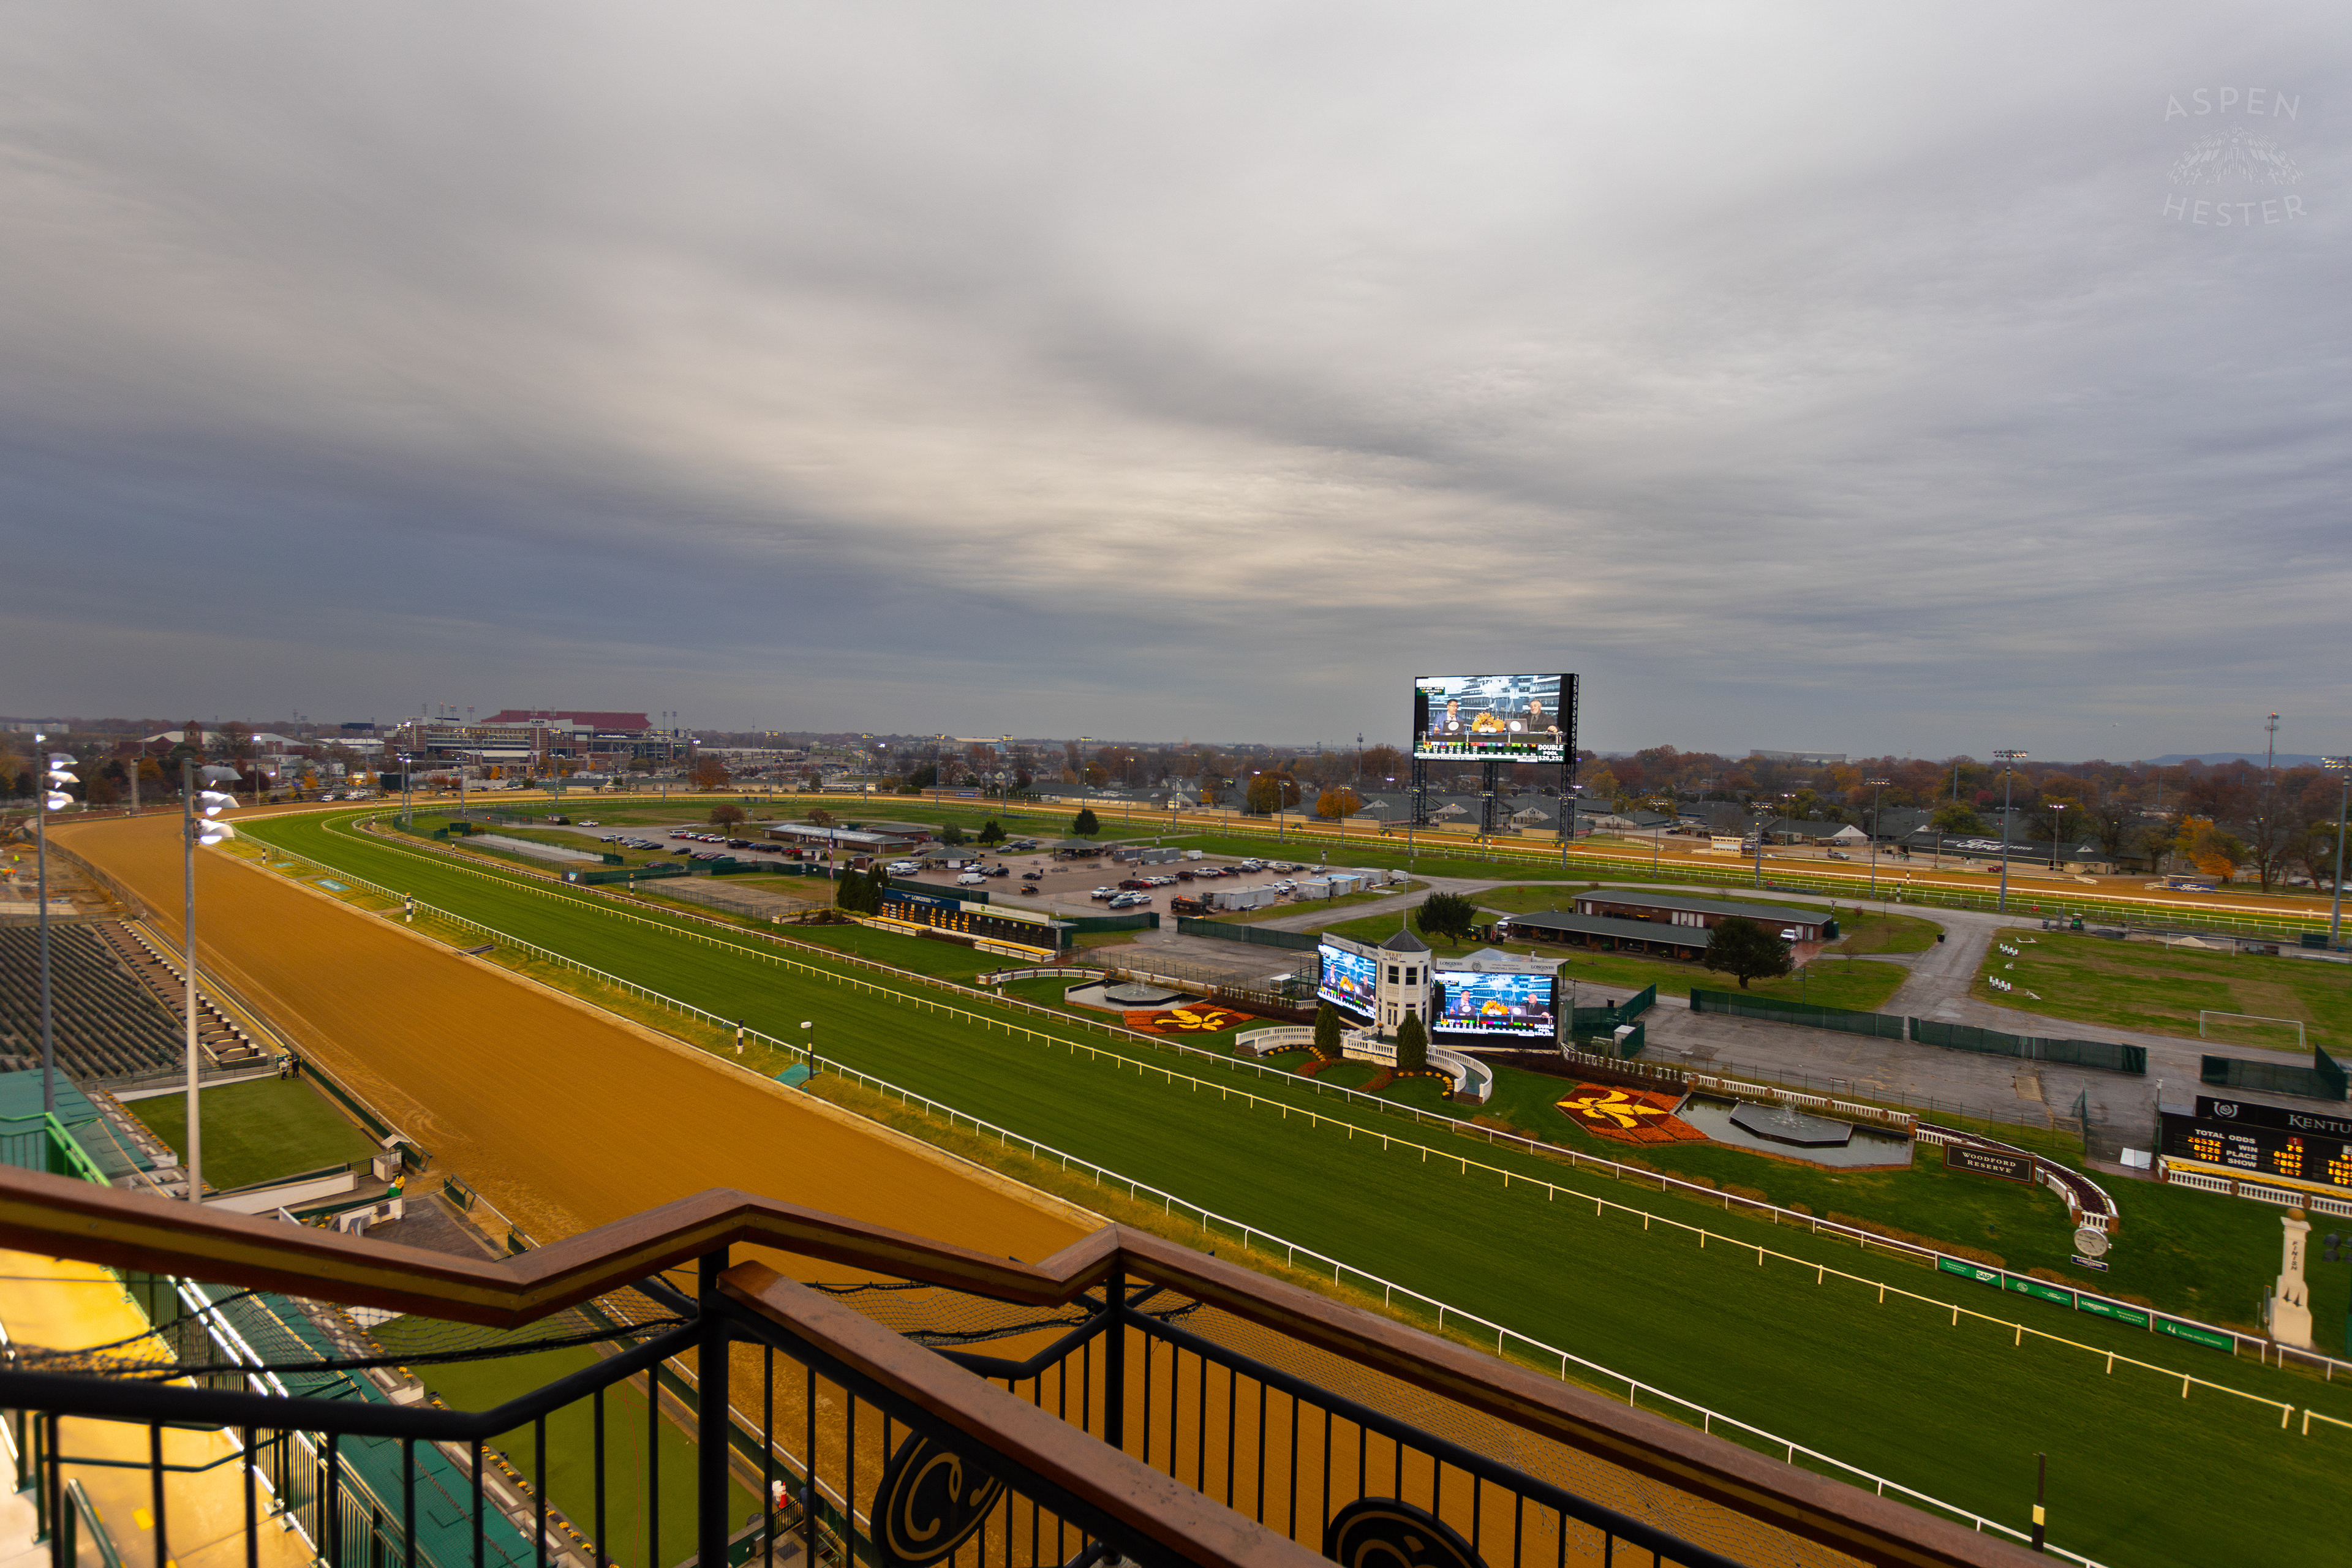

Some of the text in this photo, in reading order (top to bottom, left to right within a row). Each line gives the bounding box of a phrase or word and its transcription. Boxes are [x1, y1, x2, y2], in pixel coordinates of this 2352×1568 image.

[1956, 839, 2005, 850] Ford
[911, 895, 931, 903] LONGINES
[2195, 1129, 2225, 1139] TOTAL
[2228, 1135, 2256, 1144] ODDS
[2187, 1136, 2222, 1147] 26532
[2238, 1144, 2258, 1153] WIN
[1962, 1152, 2016, 1167] WOODFORD
[2193, 1144, 2222, 1155] 8228
[2226, 1150, 2258, 1161] PLACE
[2273, 1158, 2302, 1169] 2862
[2228, 1158, 2257, 1167] SHOW
[1967, 1159, 2011, 1174] RESERVE
[2076, 1258, 2103, 1268] LONGINES
[2081, 1300, 2110, 1311] LONGINES
